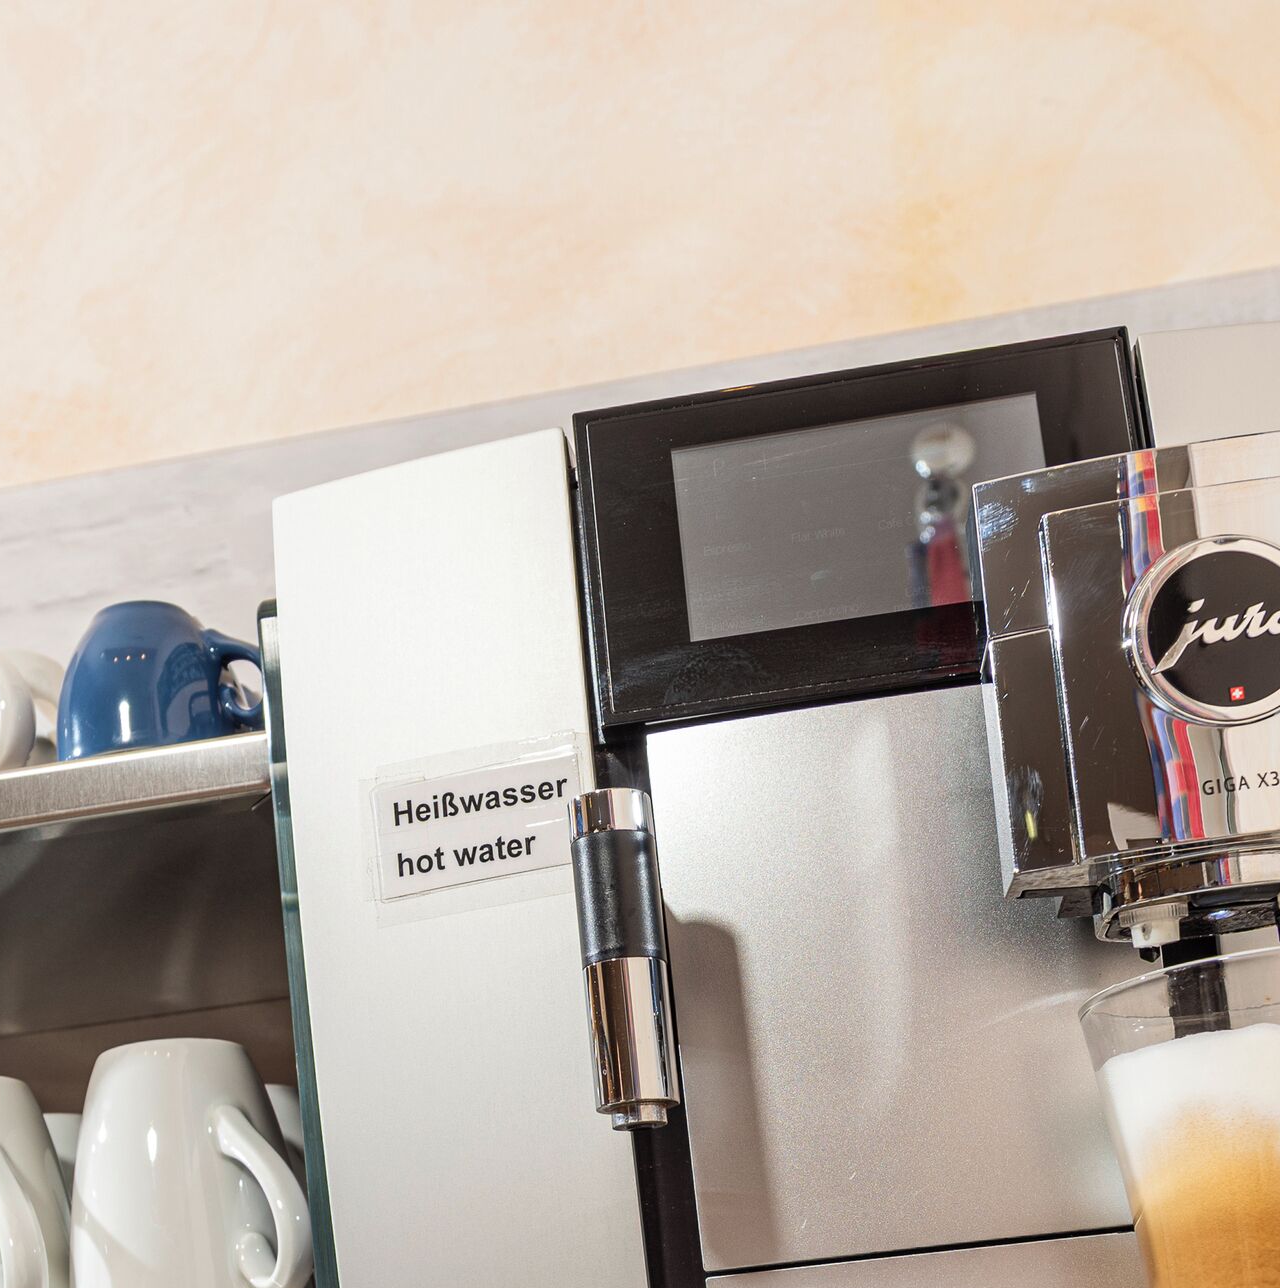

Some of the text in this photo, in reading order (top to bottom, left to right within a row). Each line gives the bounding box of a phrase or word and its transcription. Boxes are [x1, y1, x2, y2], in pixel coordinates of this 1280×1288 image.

[393, 777, 568, 826] Heißwasser
[1202, 776, 1251, 796] GIGA
[397, 835, 537, 878] hot water
